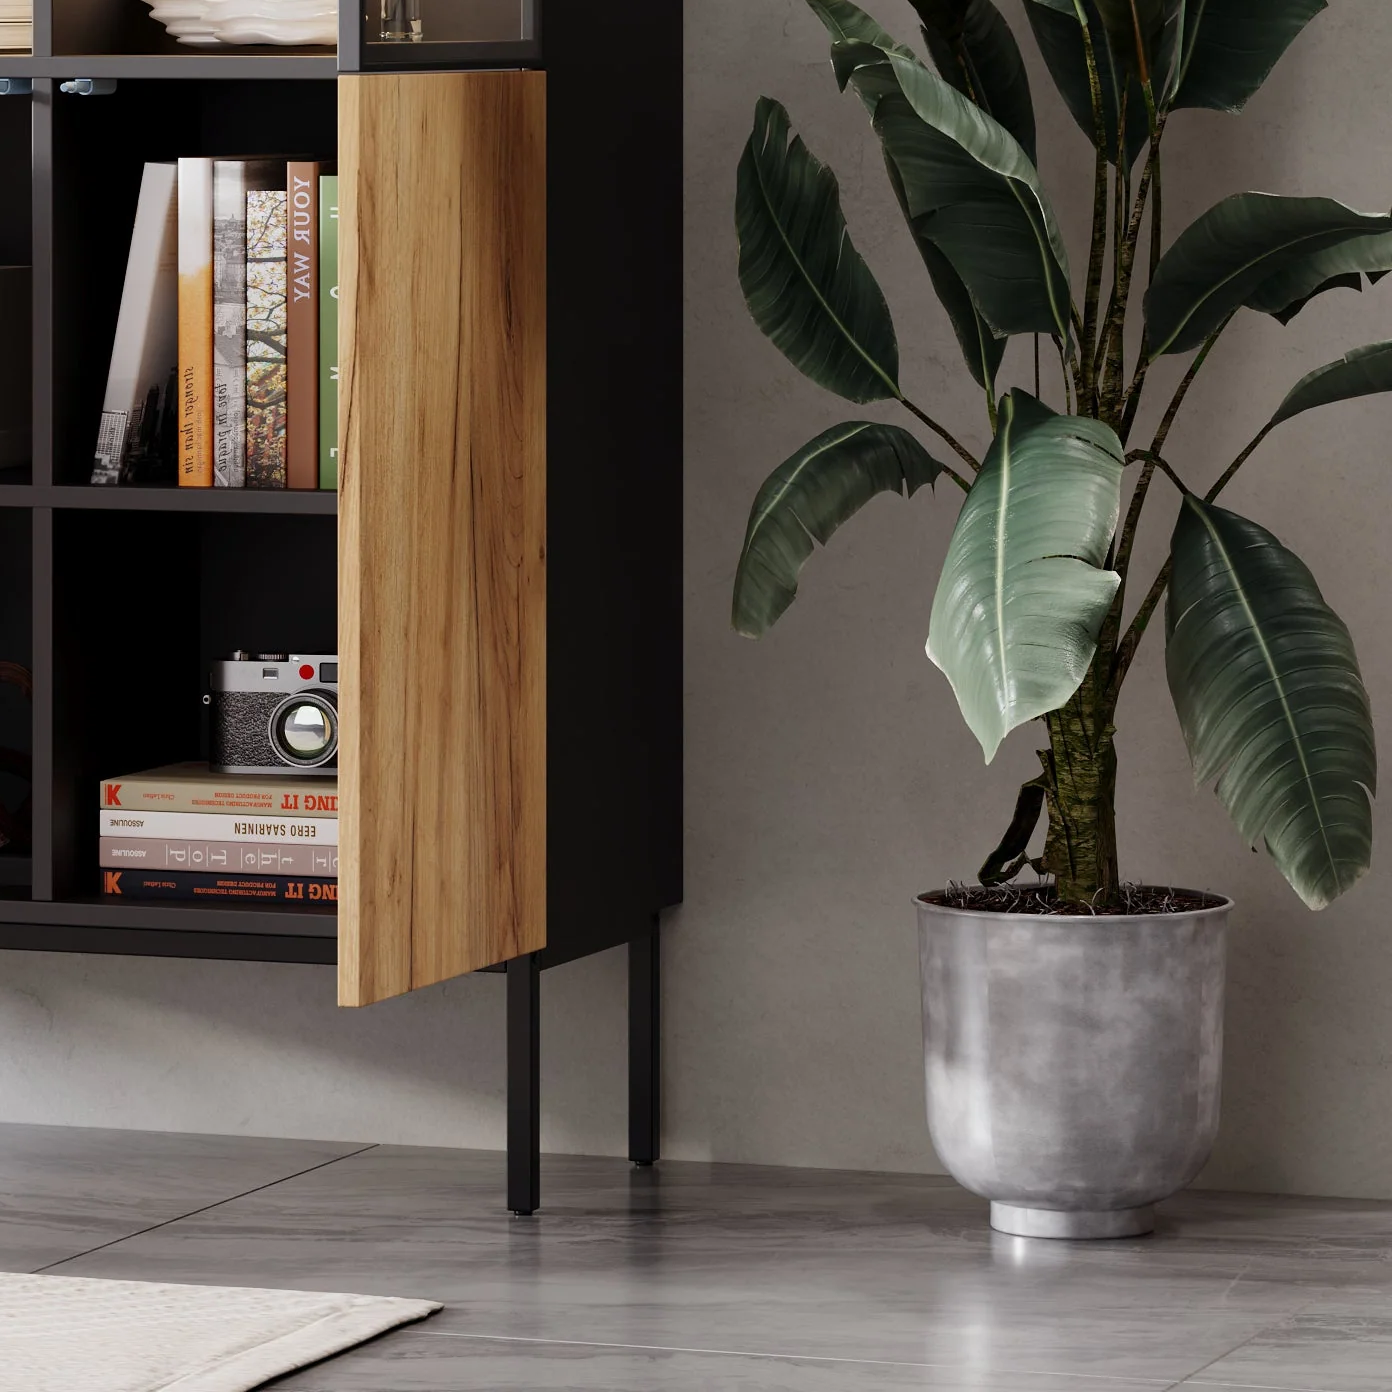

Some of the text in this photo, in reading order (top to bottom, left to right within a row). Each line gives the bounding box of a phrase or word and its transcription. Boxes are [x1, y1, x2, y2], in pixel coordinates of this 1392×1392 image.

[281, 794, 300, 810] IT
[109, 818, 145, 828] ASSOULINE
[234, 822, 317, 838] EERO SAARINEN
[111, 848, 147, 858] ASSOULINE
[284, 882, 304, 899] IT
